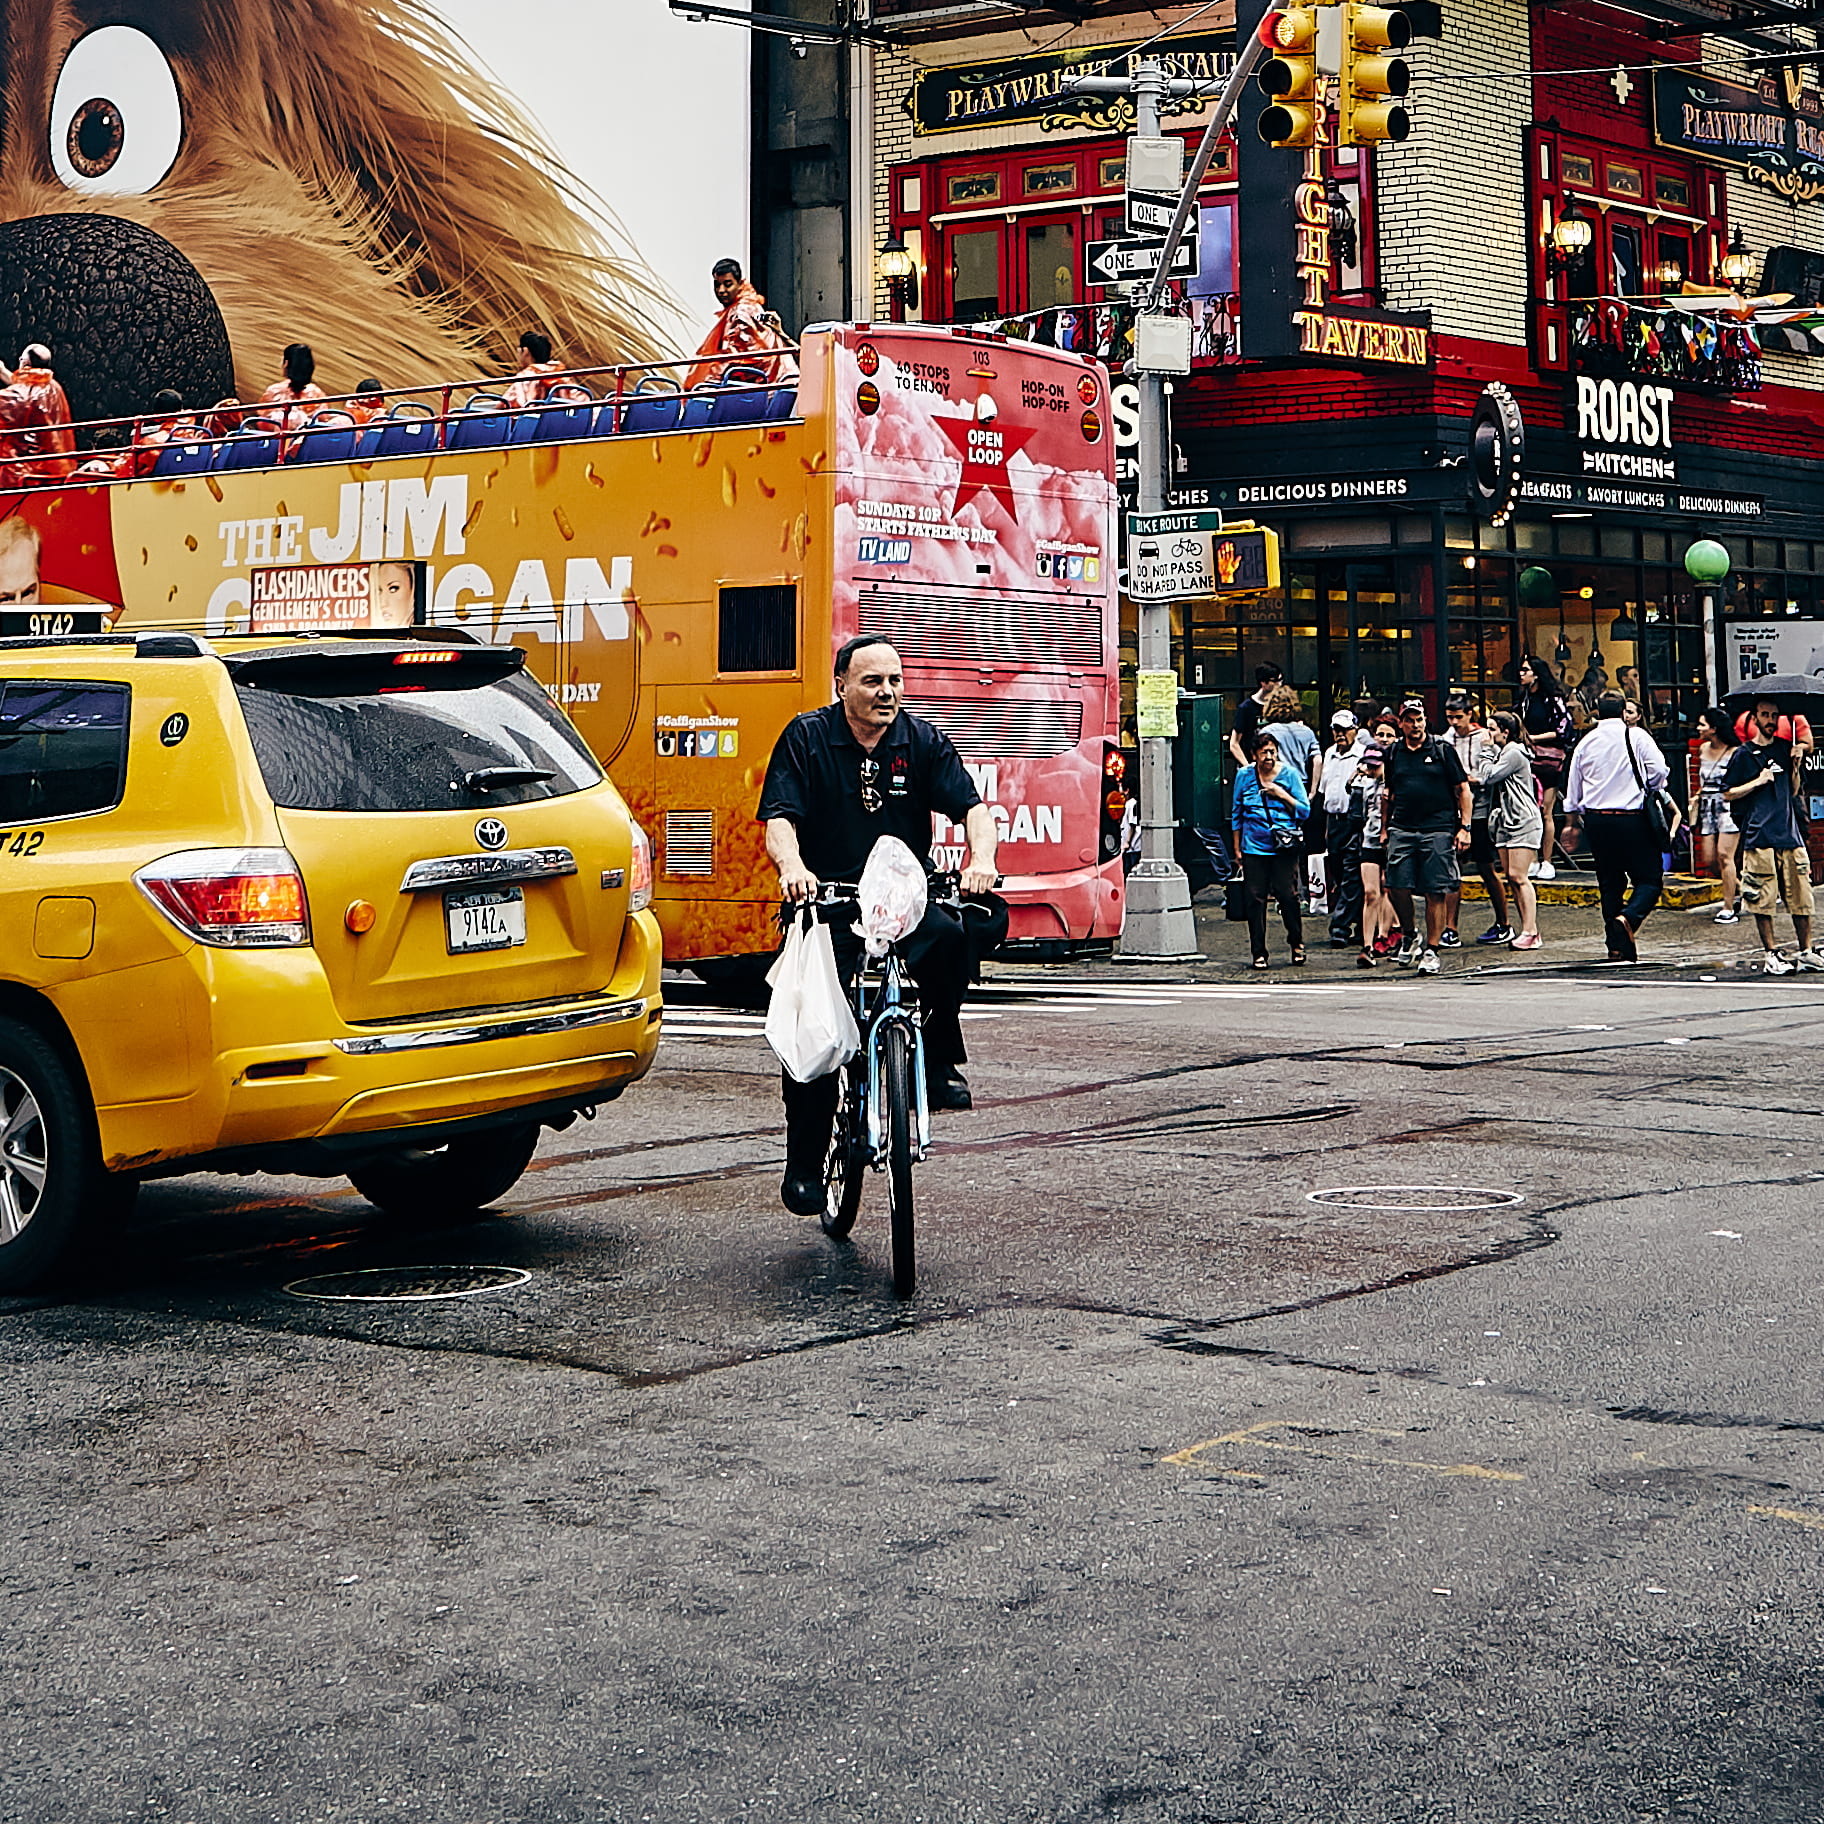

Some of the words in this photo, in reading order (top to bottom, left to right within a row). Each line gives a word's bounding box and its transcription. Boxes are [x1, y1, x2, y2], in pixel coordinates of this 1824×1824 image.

[1680, 102, 1786, 150] PLAYWRIGHT
[1136, 204, 1160, 224] ONE
[1103, 250, 1134, 270] ONE
[1150, 245, 1182, 265] WY
[1294, 311, 1429, 367] TAVERN
[972, 350, 991, 366] 103
[896, 360, 912, 376] 40
[912, 363, 951, 381] STOPS
[894, 376, 911, 391] TO
[914, 379, 952, 397] ENJOY
[1021, 379, 1067, 398] HOP-ON
[1023, 394, 1071, 414] HOP-OFF
[1577, 375, 1674, 449] ROAST
[967, 428, 1004, 449] OPEN
[967, 446, 1004, 466] LOOP
[1594, 451, 1664, 480] KITCHEN
[1238, 483, 1327, 503] DELICIOUS
[1331, 479, 1408, 500] DINNERS
[1587, 486, 1622, 504] SAVORY
[1623, 489, 1666, 508] LUNCHES
[857, 499, 916, 520] SUNDAYS
[1678, 494, 1723, 513] DELICIOUS
[219, 515, 304, 568] THE
[310, 475, 470, 562] JIM
[857, 517, 906, 537] STARTS
[907, 522, 968, 543] FATHER'S
[968, 529, 998, 546] DAY
[1136, 518, 1158, 534] BIKE
[1160, 515, 1199, 532] ROUTE
[860, 538, 879, 561] TV
[878, 541, 909, 563] LAND
[1136, 563, 1150, 578] DO
[1152, 562, 1169, 578] NOT
[1170, 560, 1204, 577] PASS
[254, 567, 370, 601] FLASHDANCERS
[1140, 580, 1177, 594] SHARED
[1181, 575, 1215, 591] LANE
[253, 600, 331, 622] GENTLEMEN'S
[334, 597, 370, 618] CLUB
[29, 613, 74, 636] 9T42
[561, 682, 601, 704] DAY
[657, 714, 738, 729] #GaffiganShow
[463, 905, 507, 937] 9T42A
